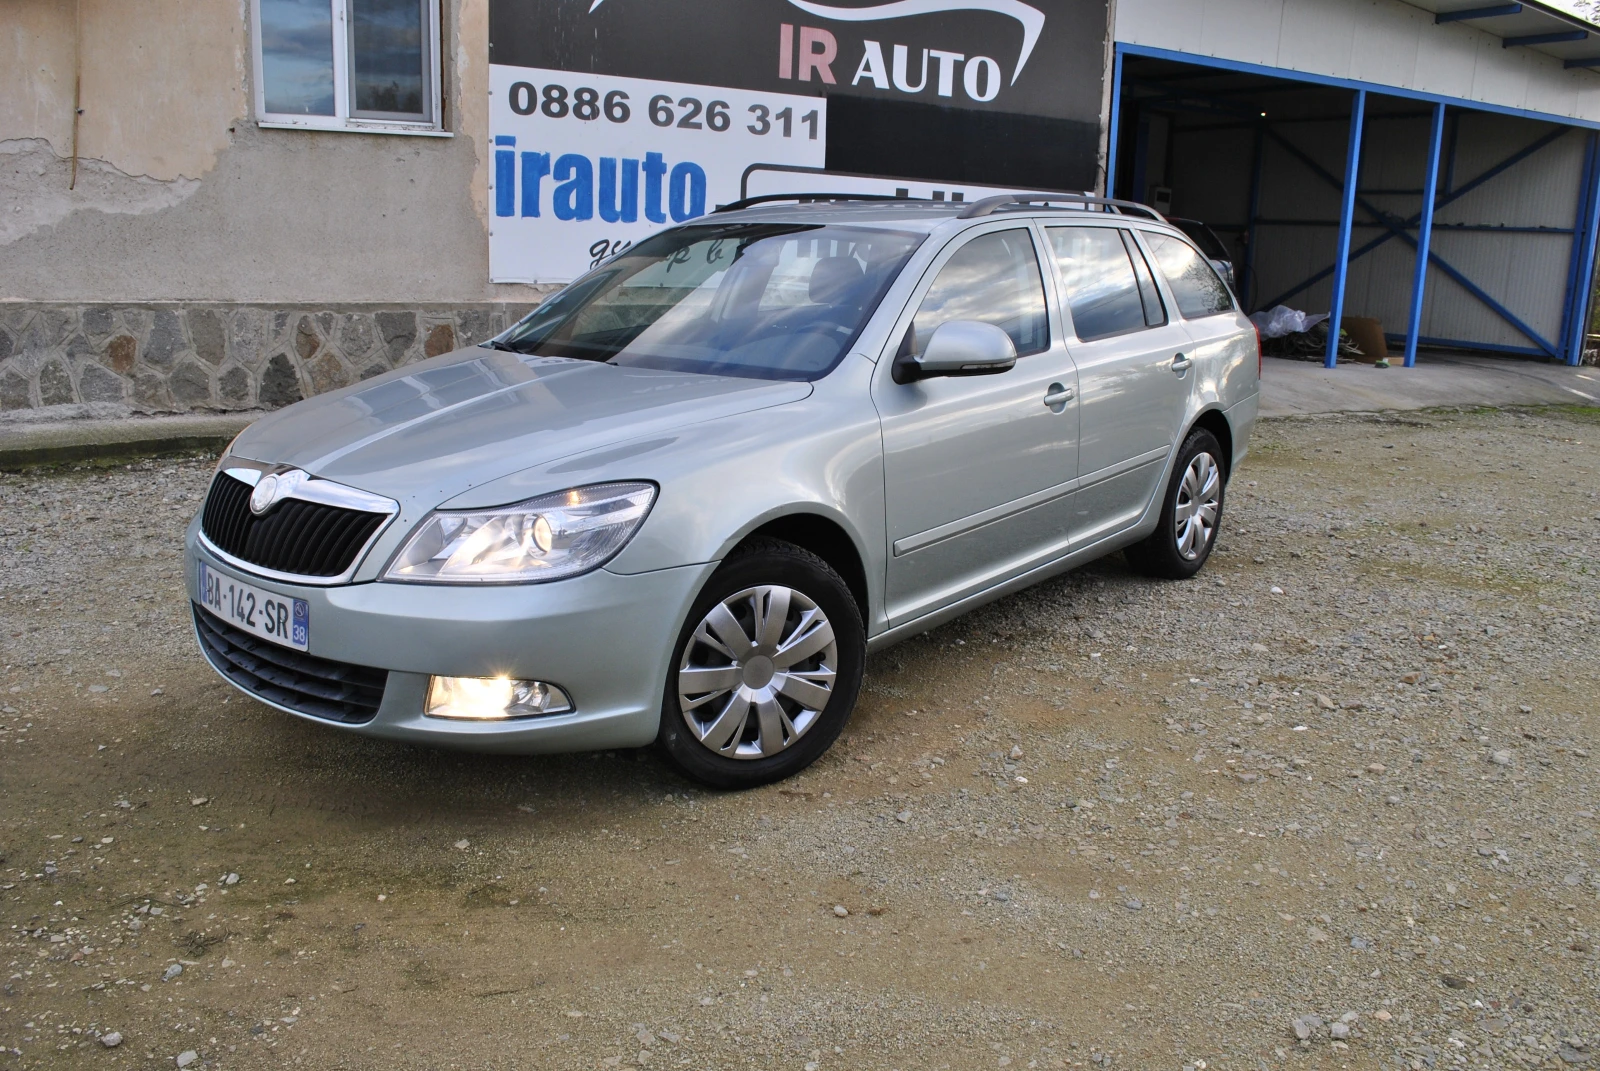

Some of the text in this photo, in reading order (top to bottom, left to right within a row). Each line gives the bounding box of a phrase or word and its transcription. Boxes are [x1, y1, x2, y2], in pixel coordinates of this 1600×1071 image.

[779, 23, 1001, 102] IR AUTO
[508, 81, 819, 140] 0886 626 311
[495, 135, 706, 224] irauto
[207, 572, 289, 640] BA-142-SR
[293, 624, 306, 642] 38
